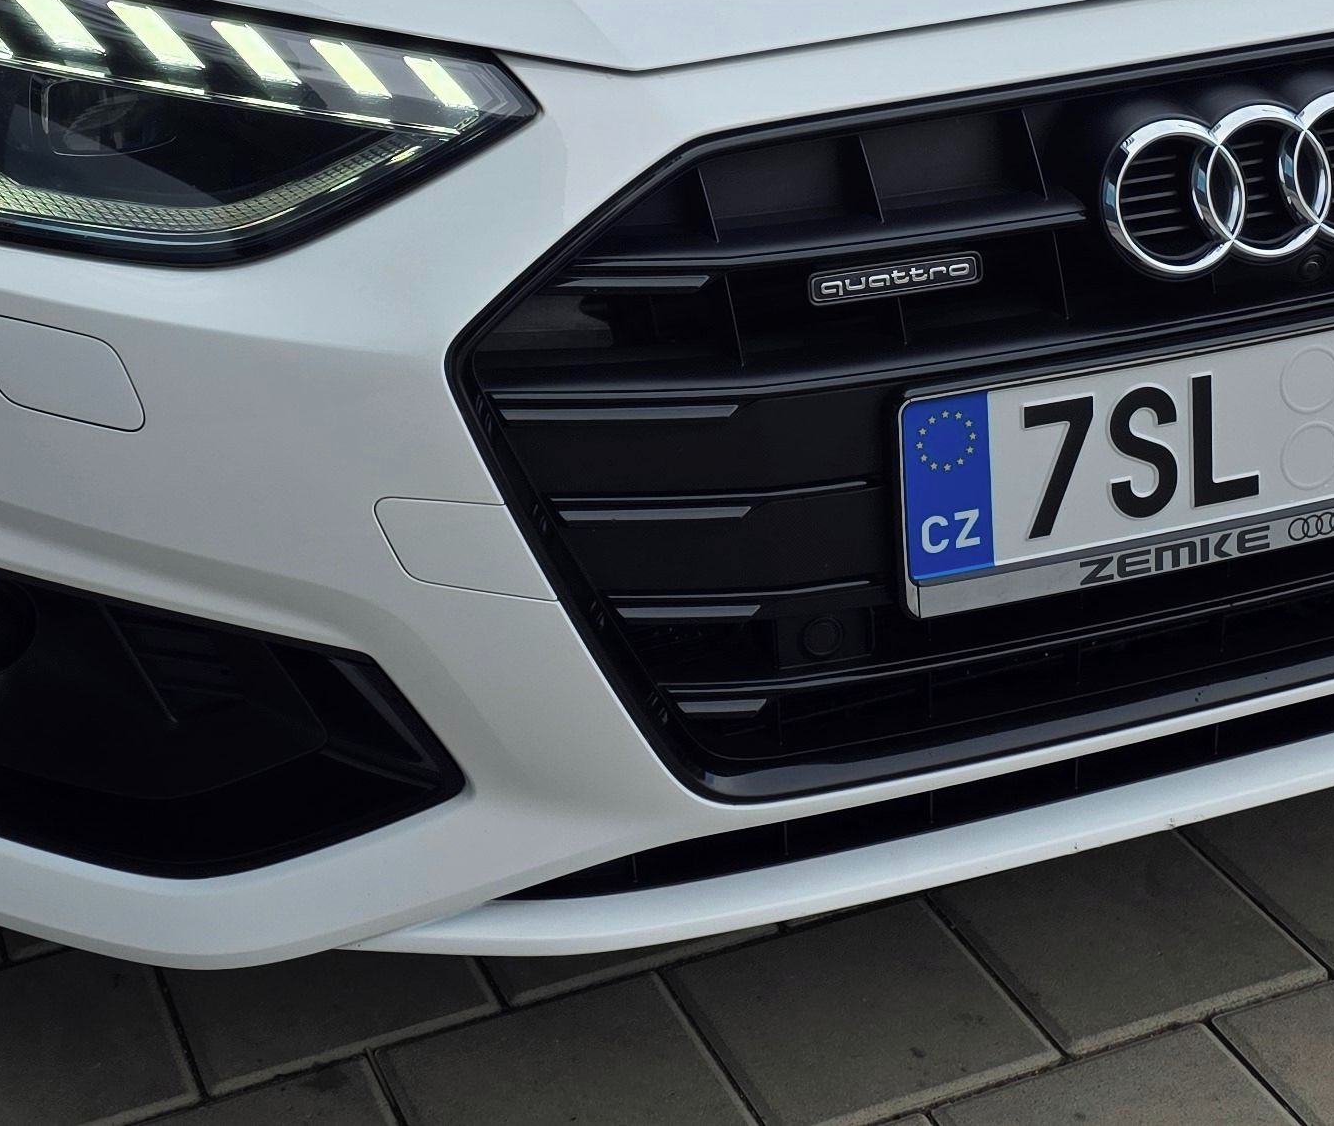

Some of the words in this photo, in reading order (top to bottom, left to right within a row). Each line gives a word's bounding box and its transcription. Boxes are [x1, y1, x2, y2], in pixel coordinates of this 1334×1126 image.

[820, 263, 970, 296] quattro
[1023, 374, 1260, 541] 7SL
[921, 508, 981, 555] CZ
[1079, 524, 1271, 587] ZEMKE
